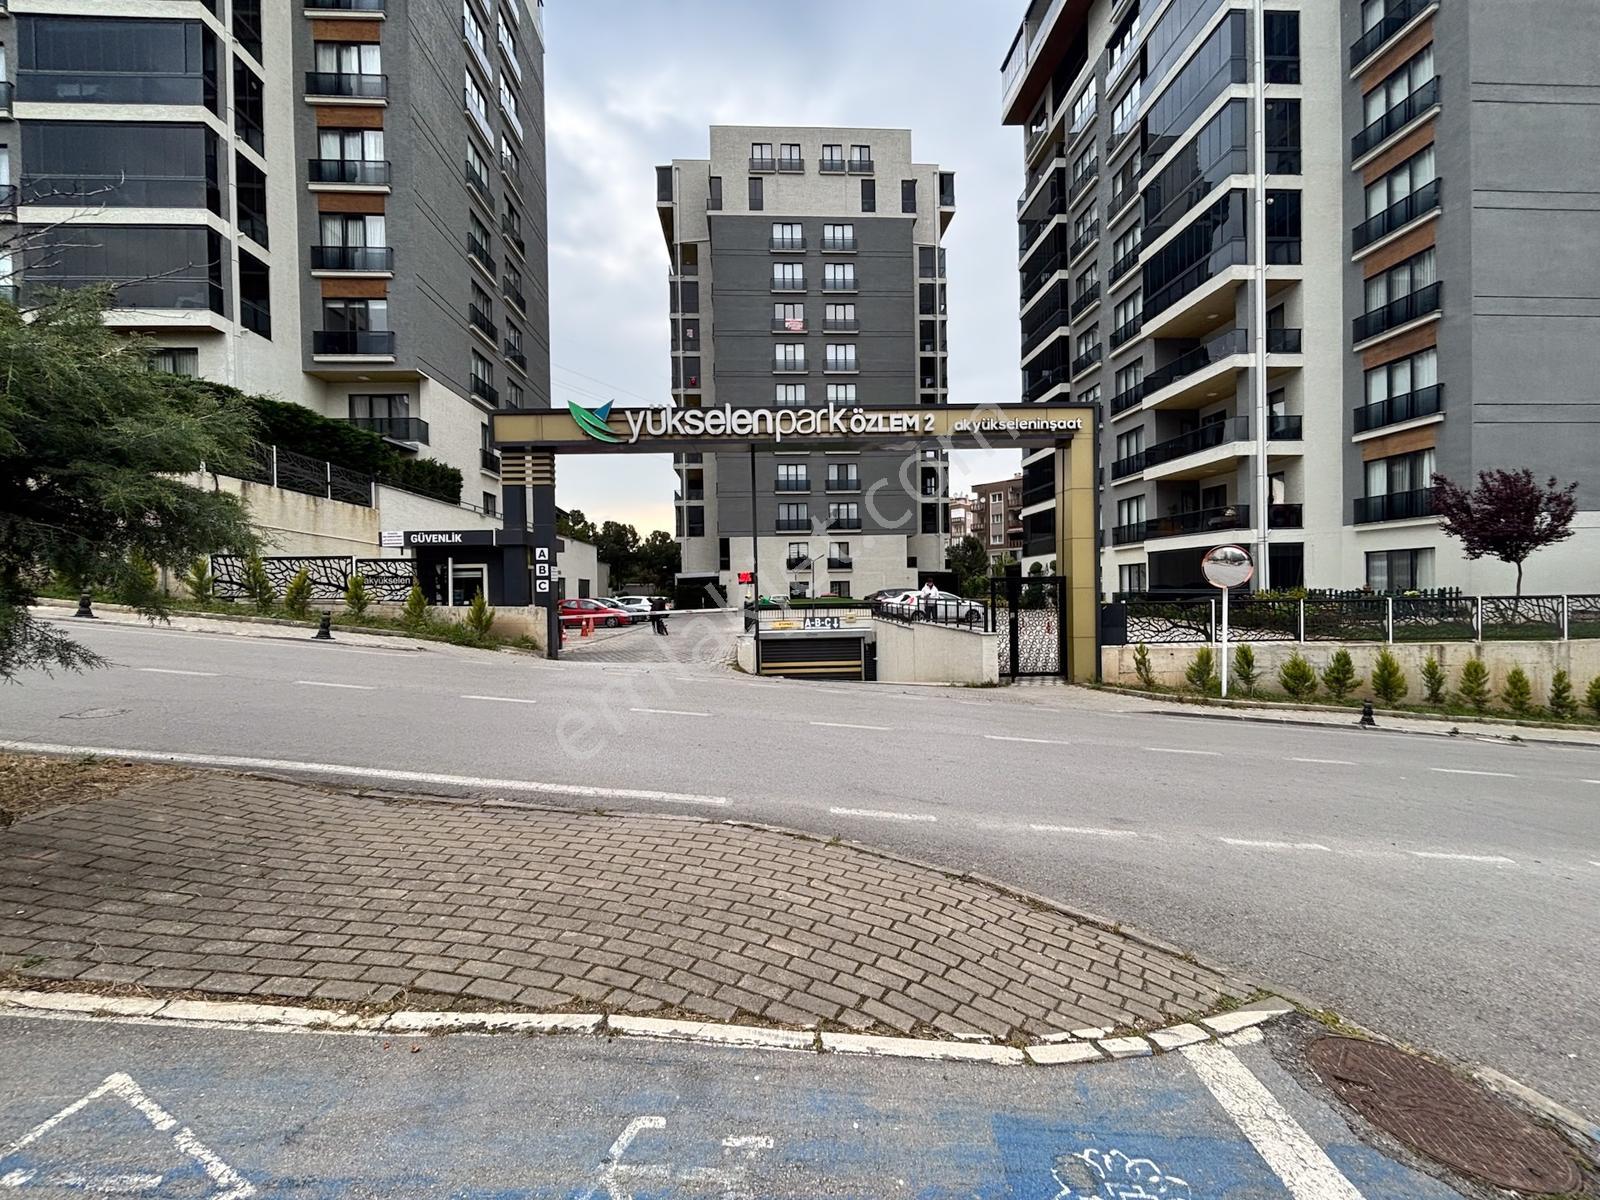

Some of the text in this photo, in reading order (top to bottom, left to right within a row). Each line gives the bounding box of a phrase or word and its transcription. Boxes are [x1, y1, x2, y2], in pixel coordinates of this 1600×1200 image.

[850, 408, 919, 433] ÖZLEM
[924, 413, 935, 432] 2
[410, 532, 463, 544] GÜVENLİK
[538, 550, 546, 559] A
[538, 566, 546, 575] B
[538, 582, 547, 591] C
[804, 617, 832, 629] A-B-C
